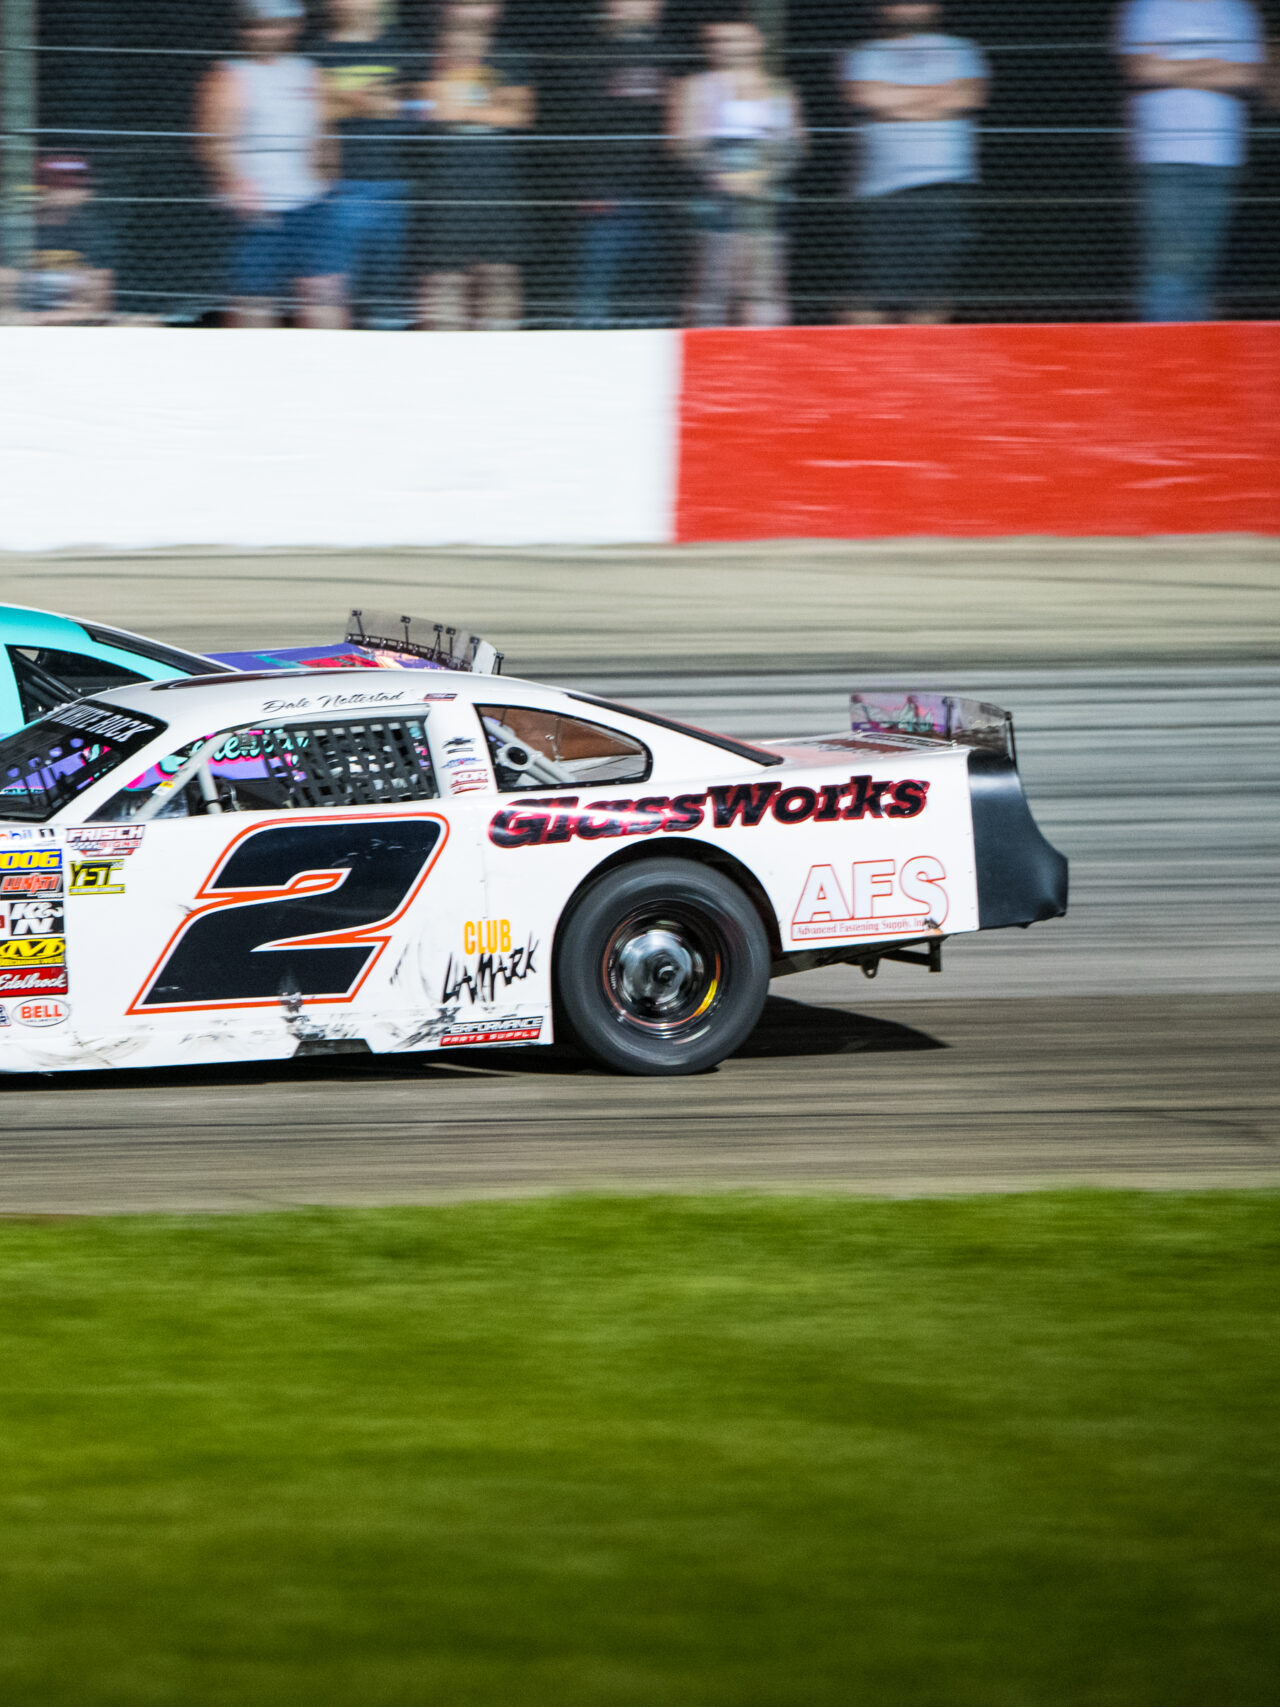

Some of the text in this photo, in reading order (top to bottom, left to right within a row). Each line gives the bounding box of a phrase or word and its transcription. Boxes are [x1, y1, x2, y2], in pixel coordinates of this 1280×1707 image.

[262, 699, 310, 714] Dale
[84, 714, 156, 743] ROCK
[488, 775, 930, 848] GlassWorks
[792, 855, 950, 925] AFS
[124, 812, 450, 1016] 2
[464, 919, 512, 955] CLUB
[796, 924, 837, 937] Advanced
[839, 921, 880, 934] Fastening
[21, 1004, 63, 1019] BELL
[441, 1030, 541, 1046] PARTS SUPPLY
